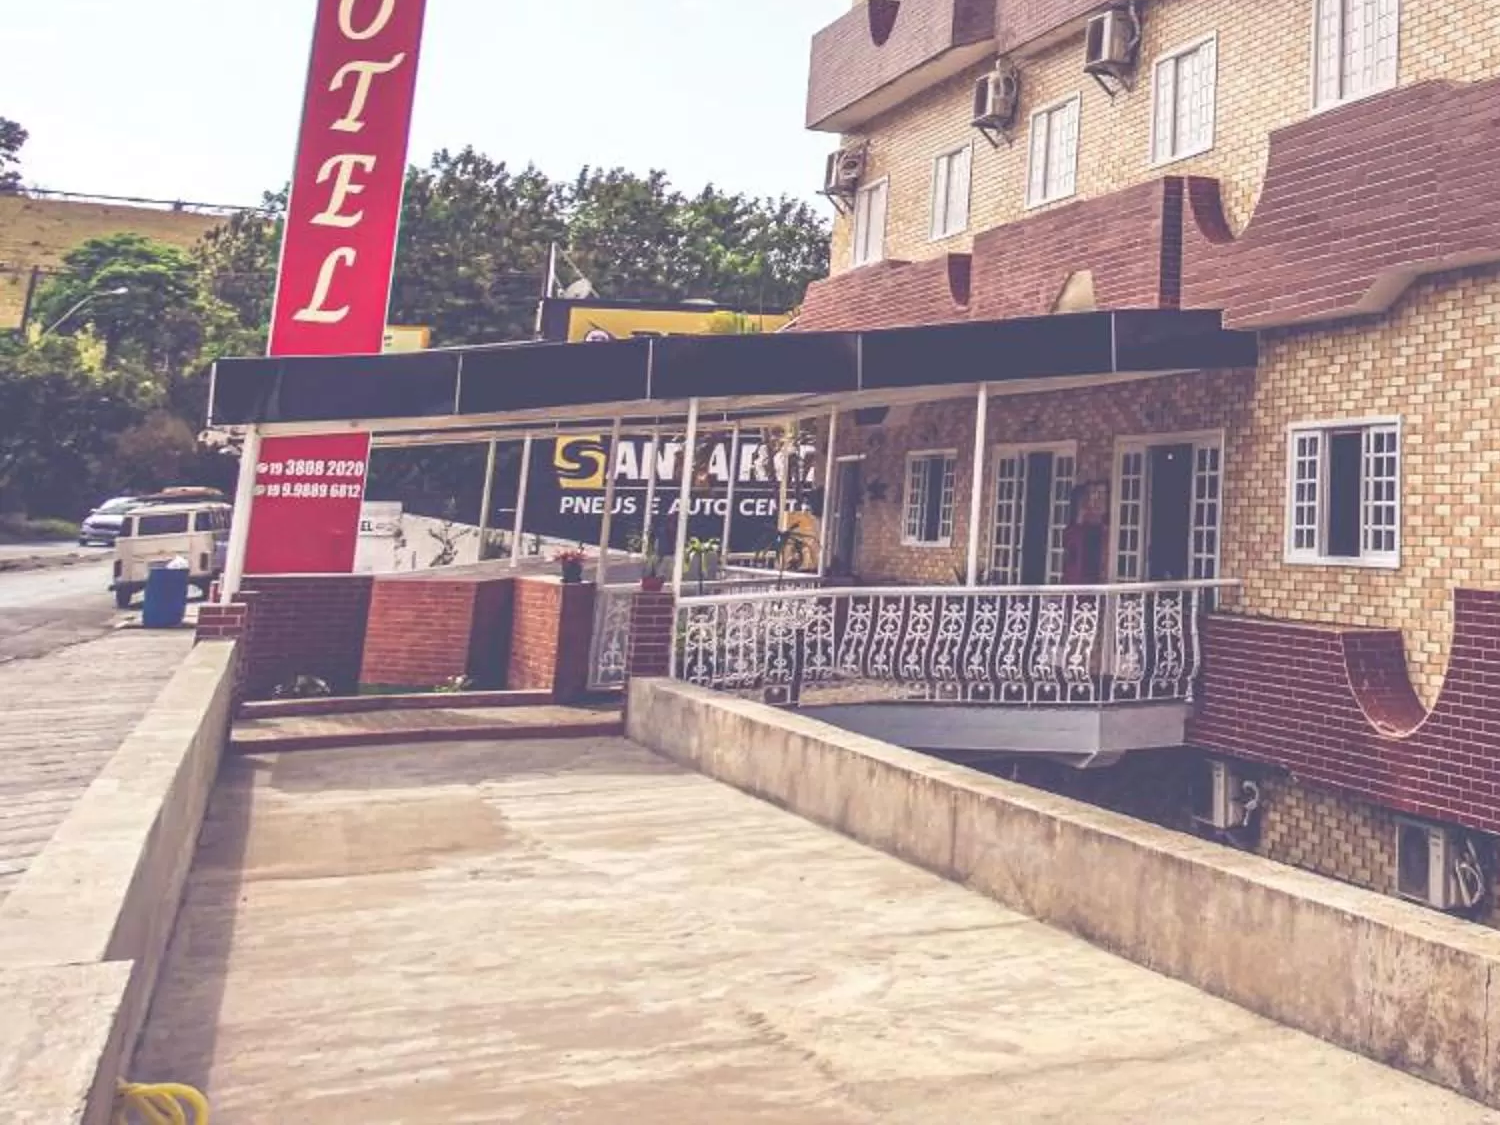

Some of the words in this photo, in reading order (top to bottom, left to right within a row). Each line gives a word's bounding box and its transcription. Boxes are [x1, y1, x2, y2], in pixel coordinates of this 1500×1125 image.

[269, 462, 283, 476] 19
[285, 458, 325, 476] 3808
[326, 460, 364, 477] 2020
